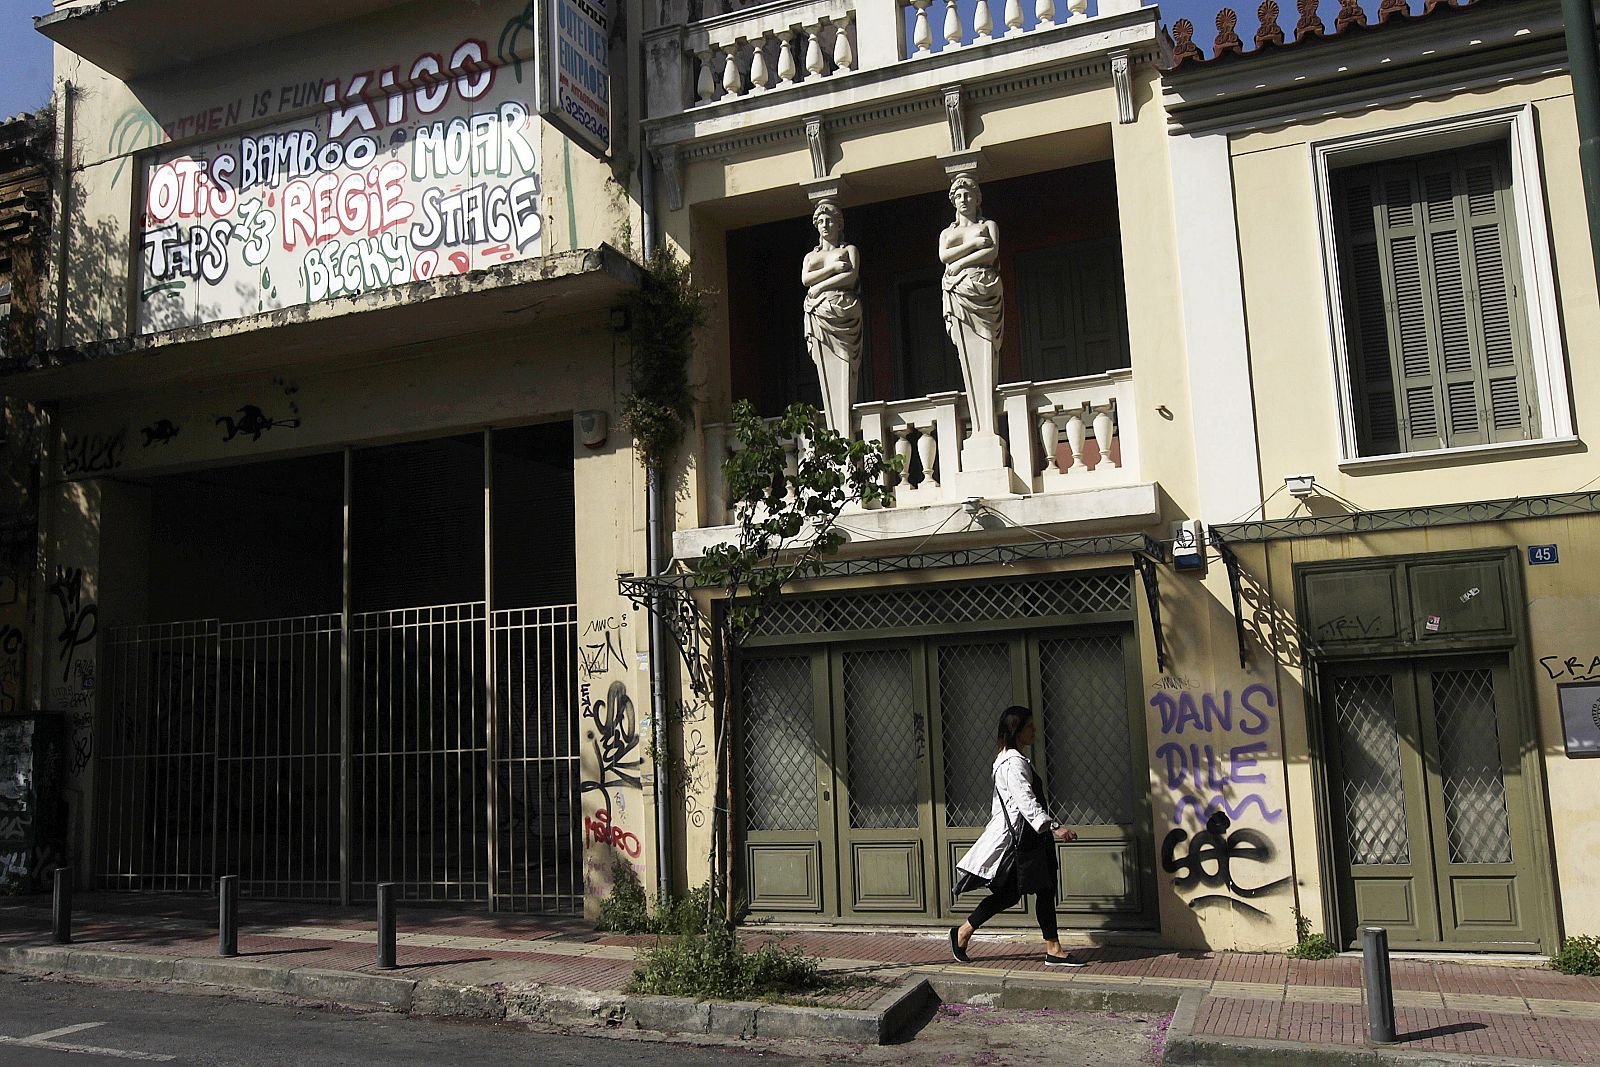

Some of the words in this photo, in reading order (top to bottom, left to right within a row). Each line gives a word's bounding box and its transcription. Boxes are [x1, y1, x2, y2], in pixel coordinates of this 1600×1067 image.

[251, 89, 272, 118] IS
[278, 77, 324, 113] FUN
[565, 96, 609, 144] 3252342
[239, 130, 379, 194] BAMBOO
[411, 100, 536, 183] MOAR
[141, 218, 233, 286] TAPS
[1535, 547, 1551, 561] 45
[1156, 741, 1268, 791] DILE
